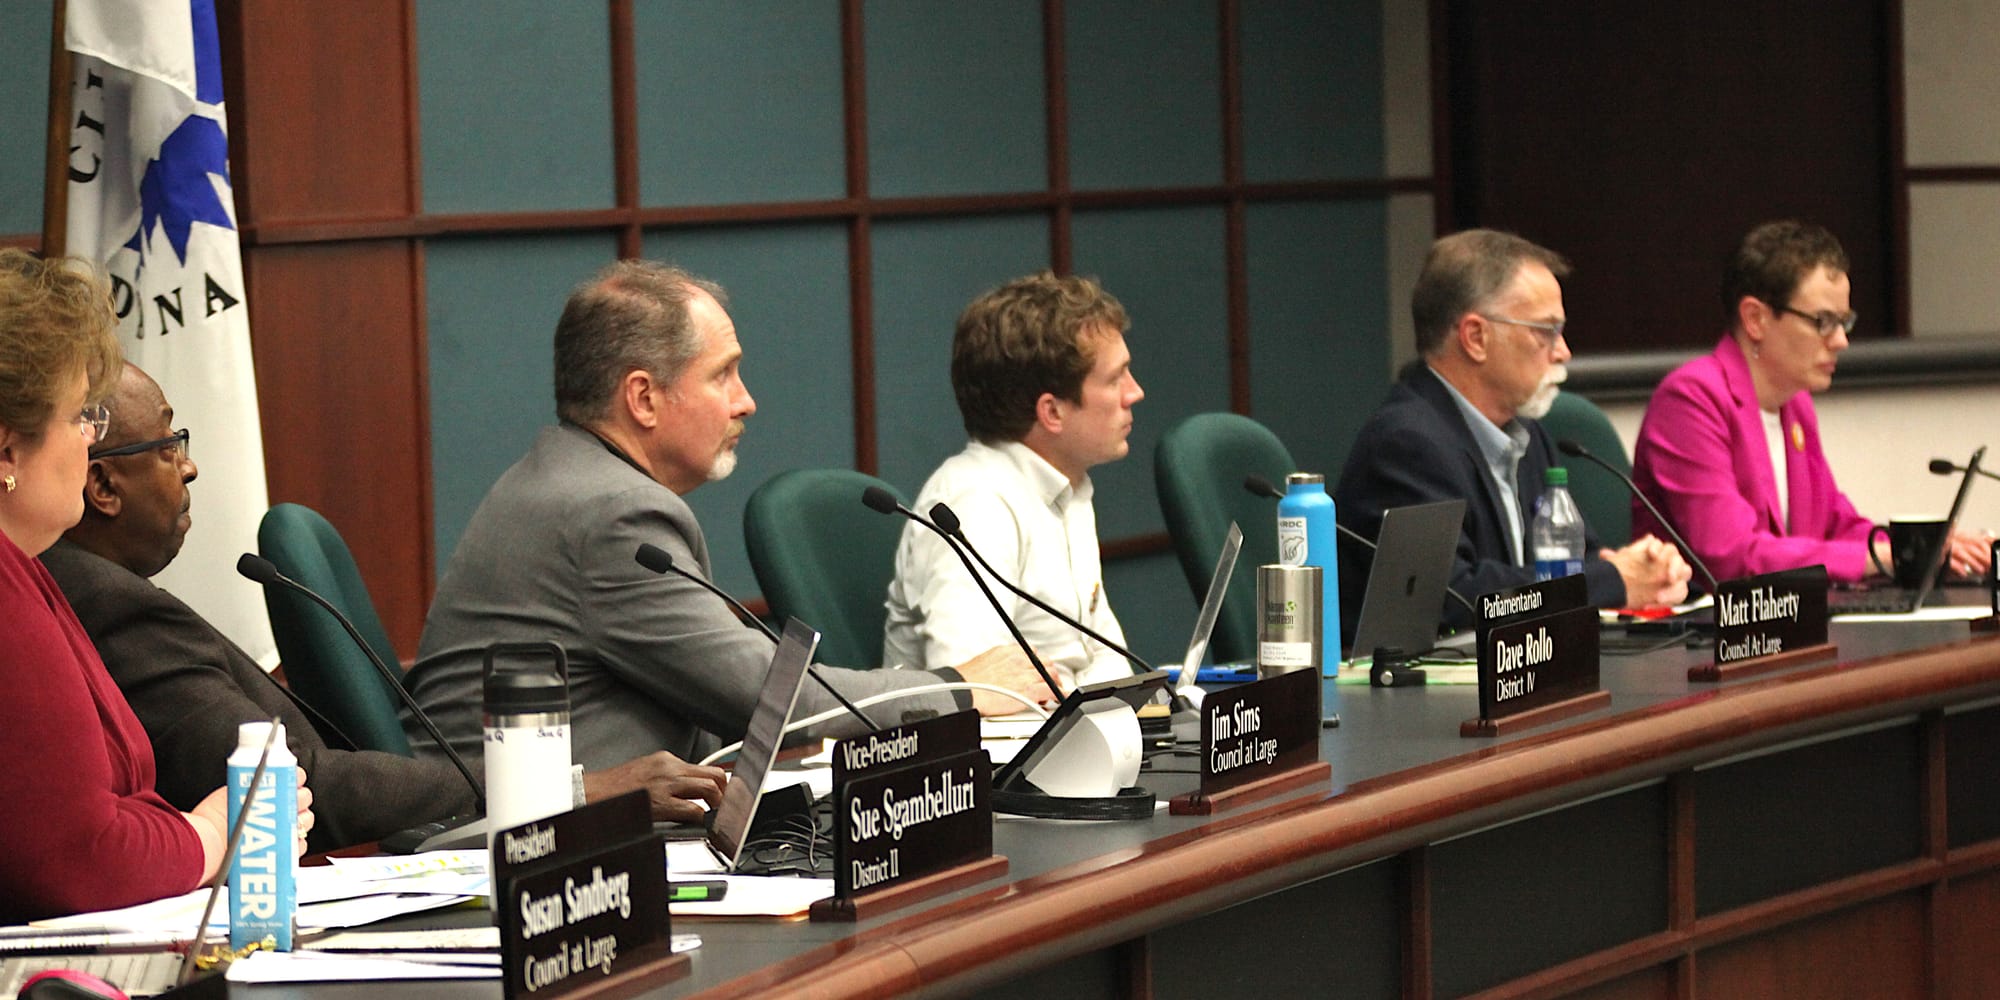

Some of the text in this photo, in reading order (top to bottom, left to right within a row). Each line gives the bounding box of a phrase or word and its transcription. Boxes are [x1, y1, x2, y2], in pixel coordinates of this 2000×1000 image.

[1483, 589, 1543, 619] Parliamentarian
[1719, 586, 1800, 628] Matt Flaherty
[1496, 626, 1553, 674] Dave Rollo
[1718, 632, 1782, 663] Council At Large
[1496, 671, 1536, 702] District IV
[1210, 699, 1261, 751] Jim Sims
[843, 728, 919, 771] Vice-President
[1210, 736, 1278, 774] Council at Large
[851, 767, 975, 843] Sue Sgambelluri
[239, 787, 277, 921] WATER
[505, 824, 556, 864] President
[852, 848, 899, 890] District II
[520, 866, 631, 939] Susan Sandberg
[524, 934, 617, 992] Council at Large
